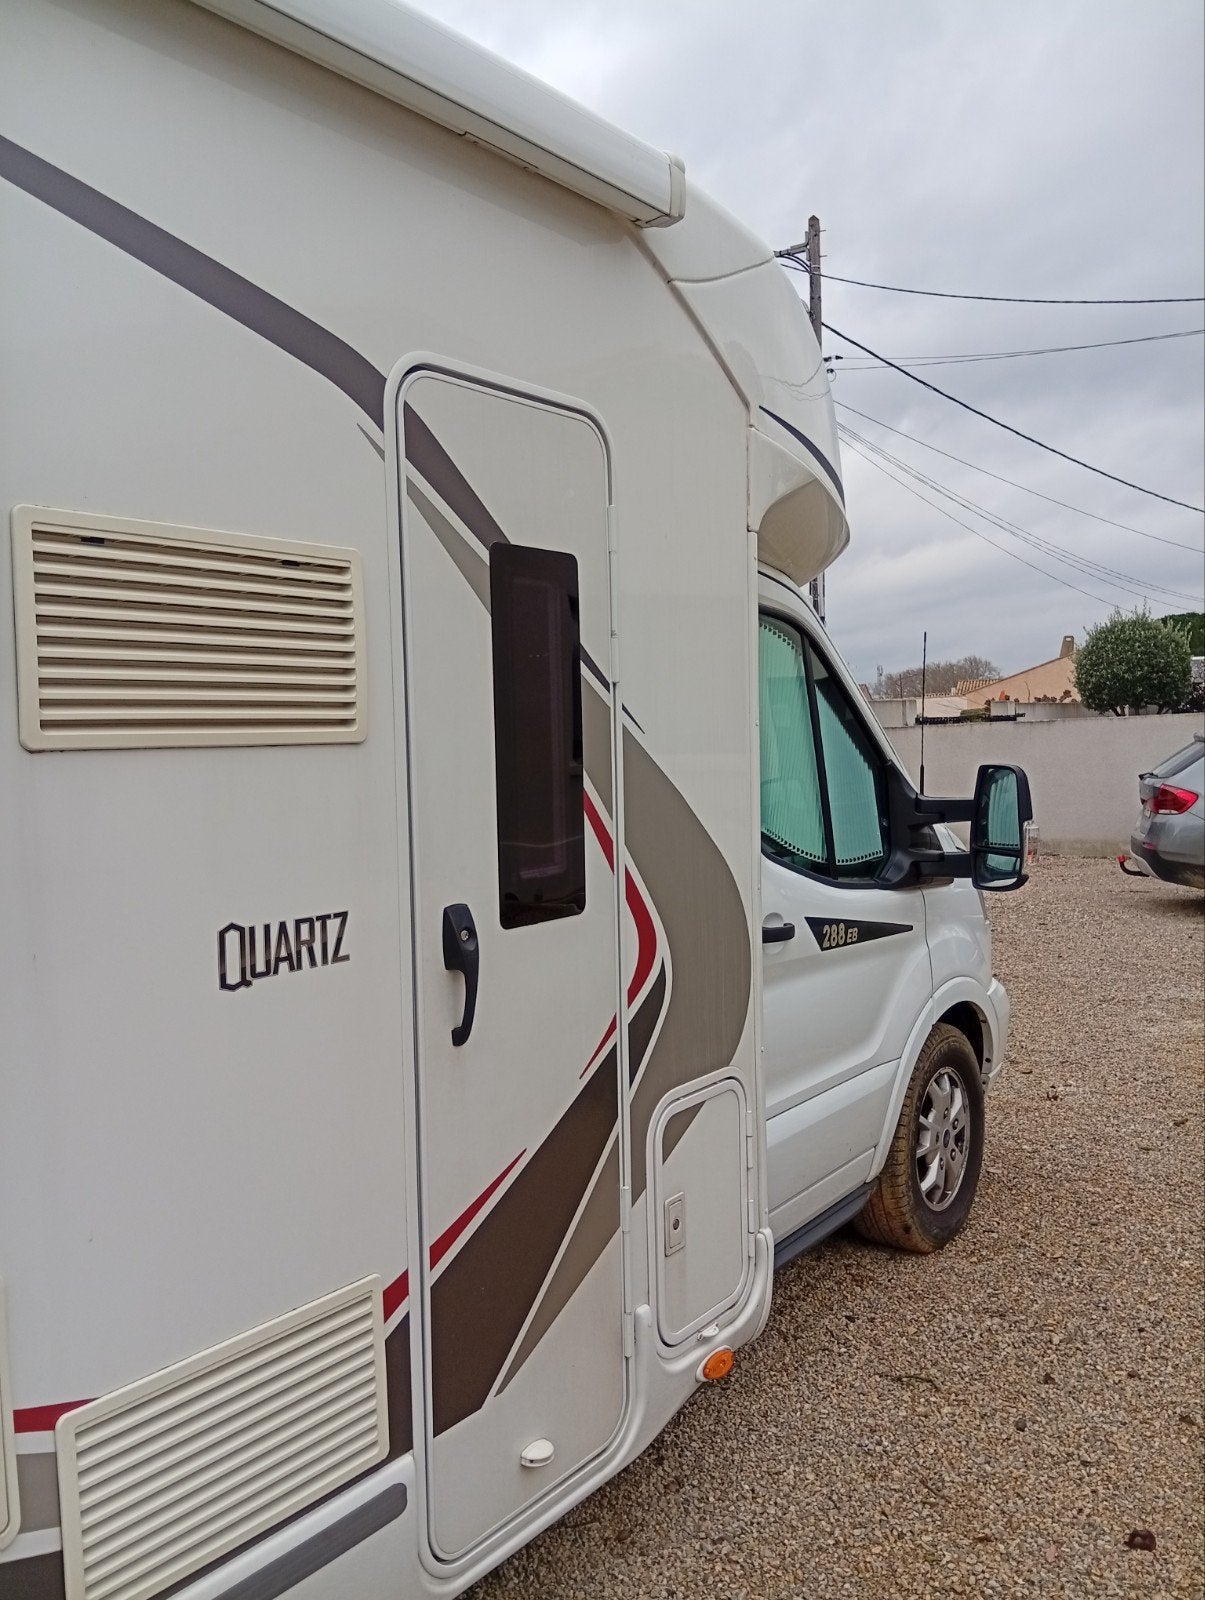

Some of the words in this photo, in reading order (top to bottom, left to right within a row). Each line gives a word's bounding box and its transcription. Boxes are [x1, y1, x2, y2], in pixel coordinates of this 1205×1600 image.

[217, 910, 350, 991] QUARTZ
[823, 923, 846, 948] 288
[847, 927, 859, 943] EB
